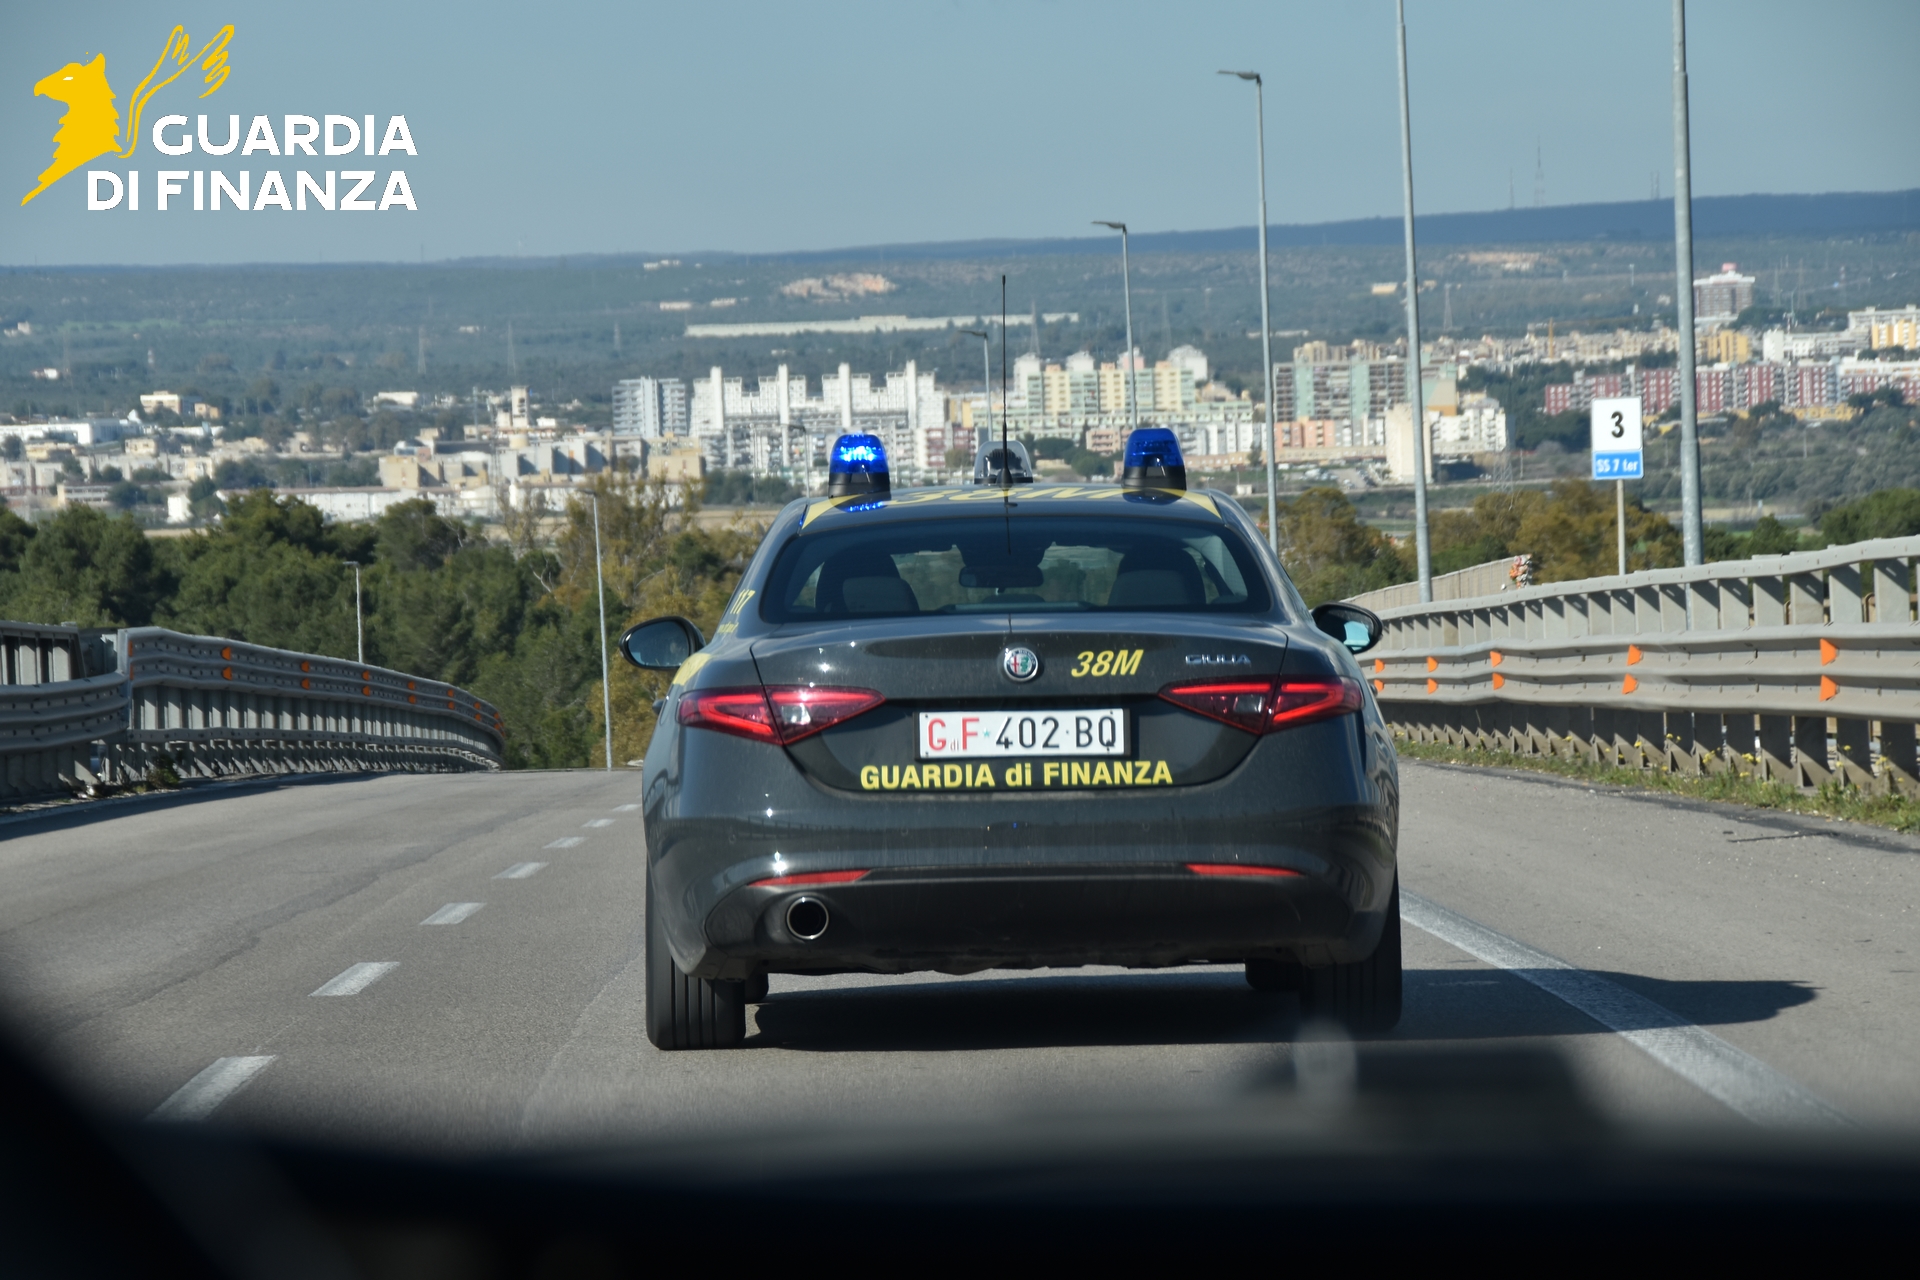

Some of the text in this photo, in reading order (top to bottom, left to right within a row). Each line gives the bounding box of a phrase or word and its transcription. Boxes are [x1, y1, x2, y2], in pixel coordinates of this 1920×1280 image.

[1611, 411, 1624, 438] 3
[1597, 458, 1639, 473] SS 7 ter
[730, 589, 755, 614] 117
[1071, 649, 1144, 677] 38M
[995, 716, 1060, 749] 402
[860, 760, 1173, 790] GUARDIA di FINANZA
